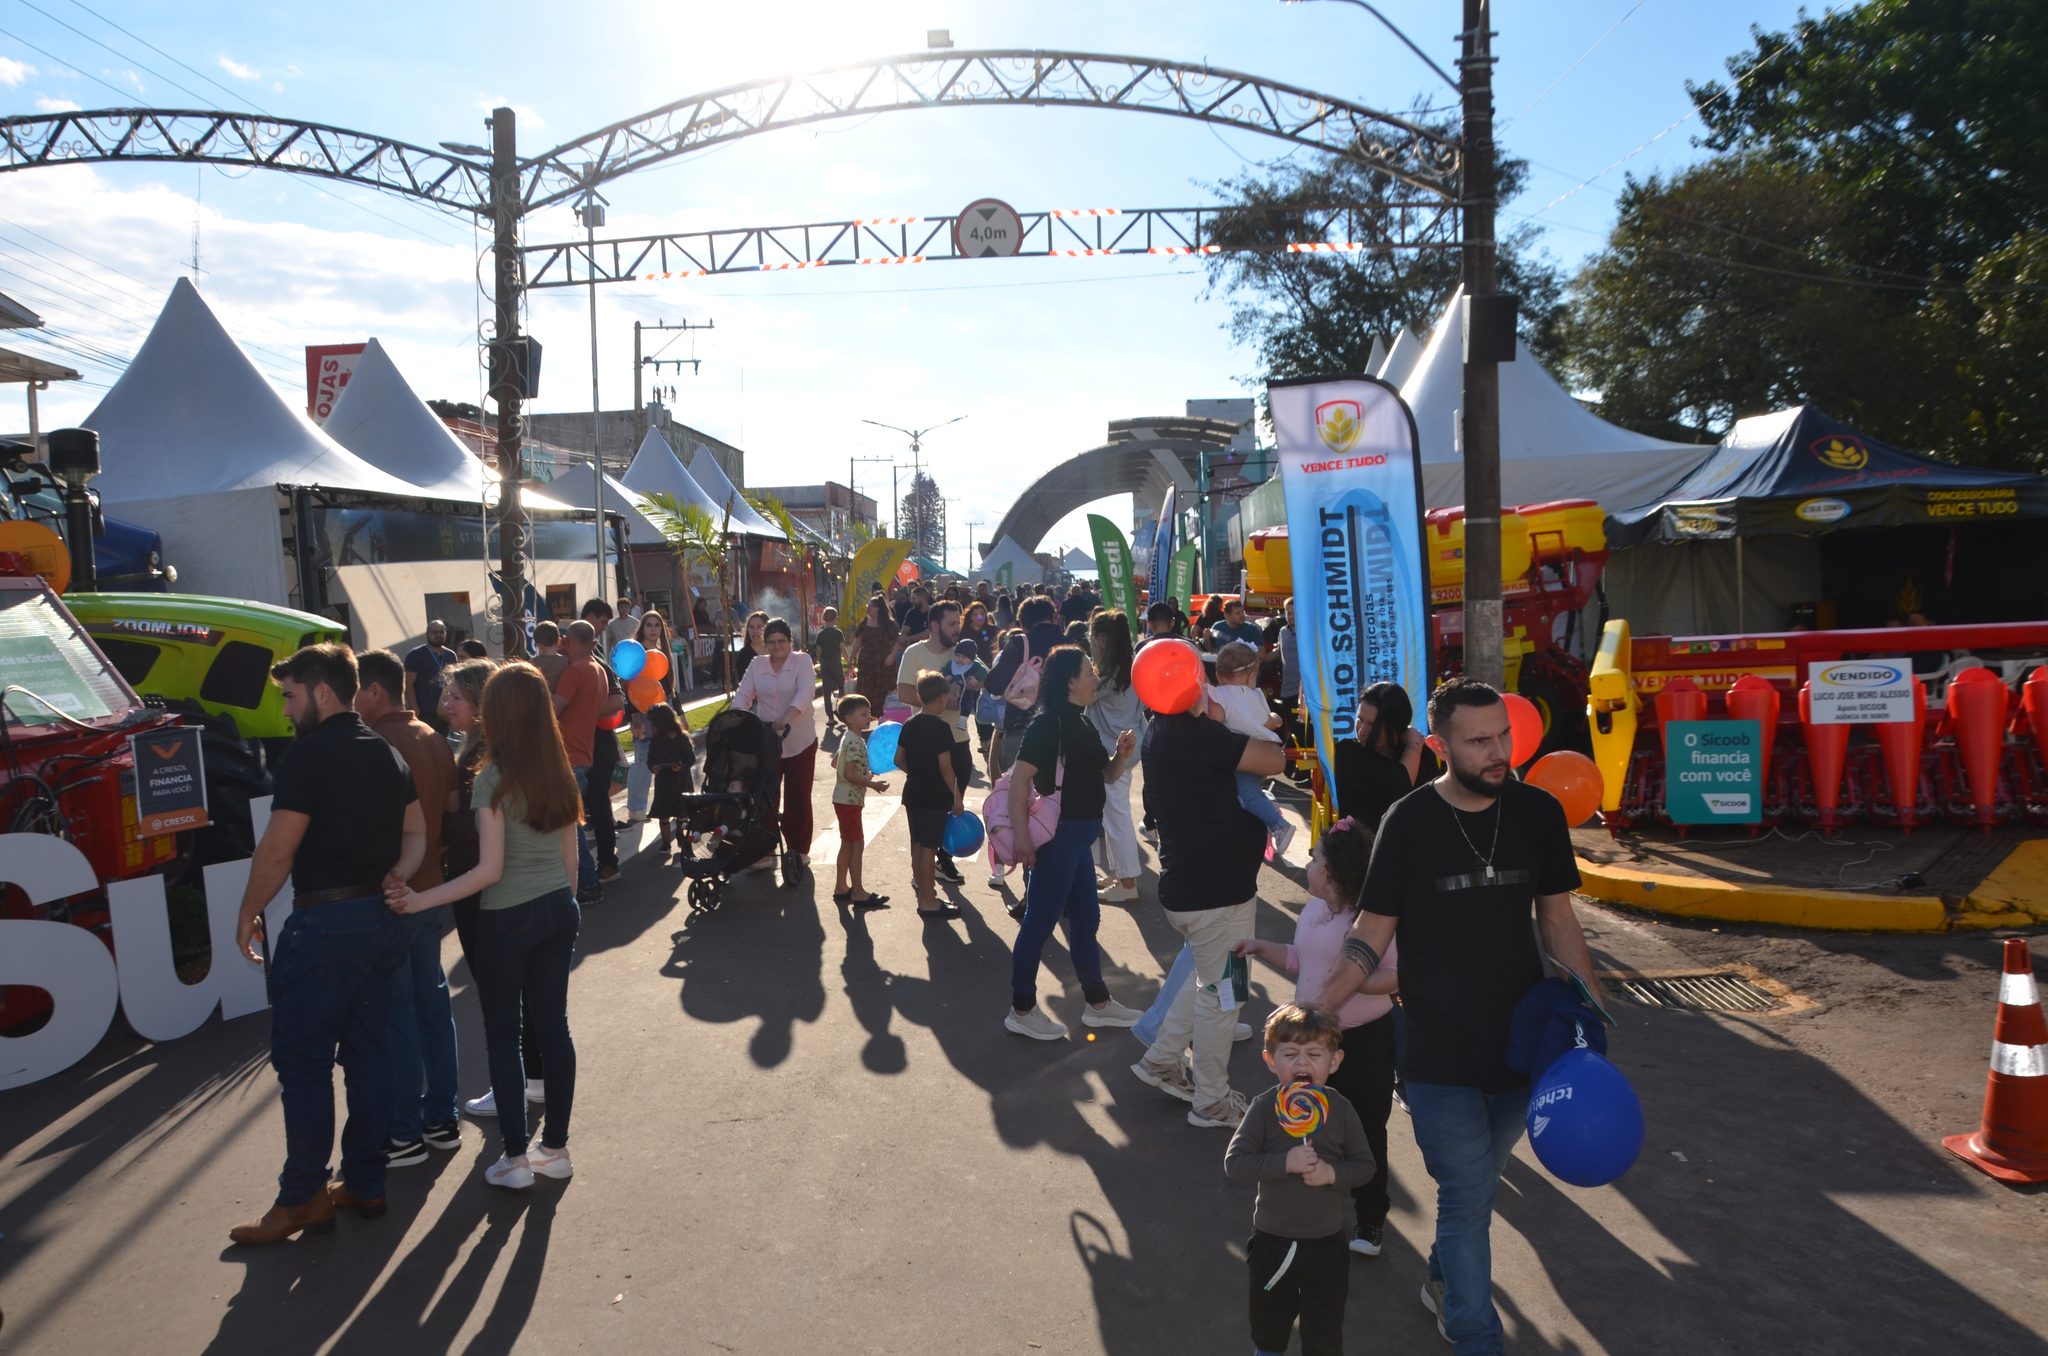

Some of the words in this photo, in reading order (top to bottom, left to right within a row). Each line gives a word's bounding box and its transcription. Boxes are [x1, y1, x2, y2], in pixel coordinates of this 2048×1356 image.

[970, 226, 1007, 242] 4,0m
[316, 359, 339, 418] OJAS
[1301, 460, 1344, 473] VENCE
[1347, 454, 1386, 469] TUDO
[1926, 502, 1975, 516] VENCE
[1978, 500, 2018, 515] TUDO
[1103, 540, 1128, 610] icredi
[1319, 507, 1353, 653] SCHMIDT
[1435, 588, 1462, 601] 9200
[111, 618, 210, 637] ZOOMLION
[1829, 671, 1893, 681] VENDIDO
[1333, 663, 1356, 741] ULIO
[1813, 692, 1835, 701] LUCIO
[1837, 691, 1855, 700] JOSE
[1857, 691, 1877, 699] MORO
[1880, 689, 1910, 698] ALESSIO
[1837, 704, 1857, 713] Apoio
[1859, 703, 1887, 711] SICOOB
[1684, 733, 1697, 747] O
[1702, 733, 1750, 747] Sicoob
[1691, 750, 1750, 764] financia
[159, 764, 188, 775] CRESOL
[1680, 771, 1712, 782] com
[1716, 768, 1752, 782] você
[150, 774, 193, 787] FINANCIA
[152, 789, 171, 797] PARA
[172, 784, 193, 795] VOCÊ!
[164, 815, 195, 827] CRESOL
